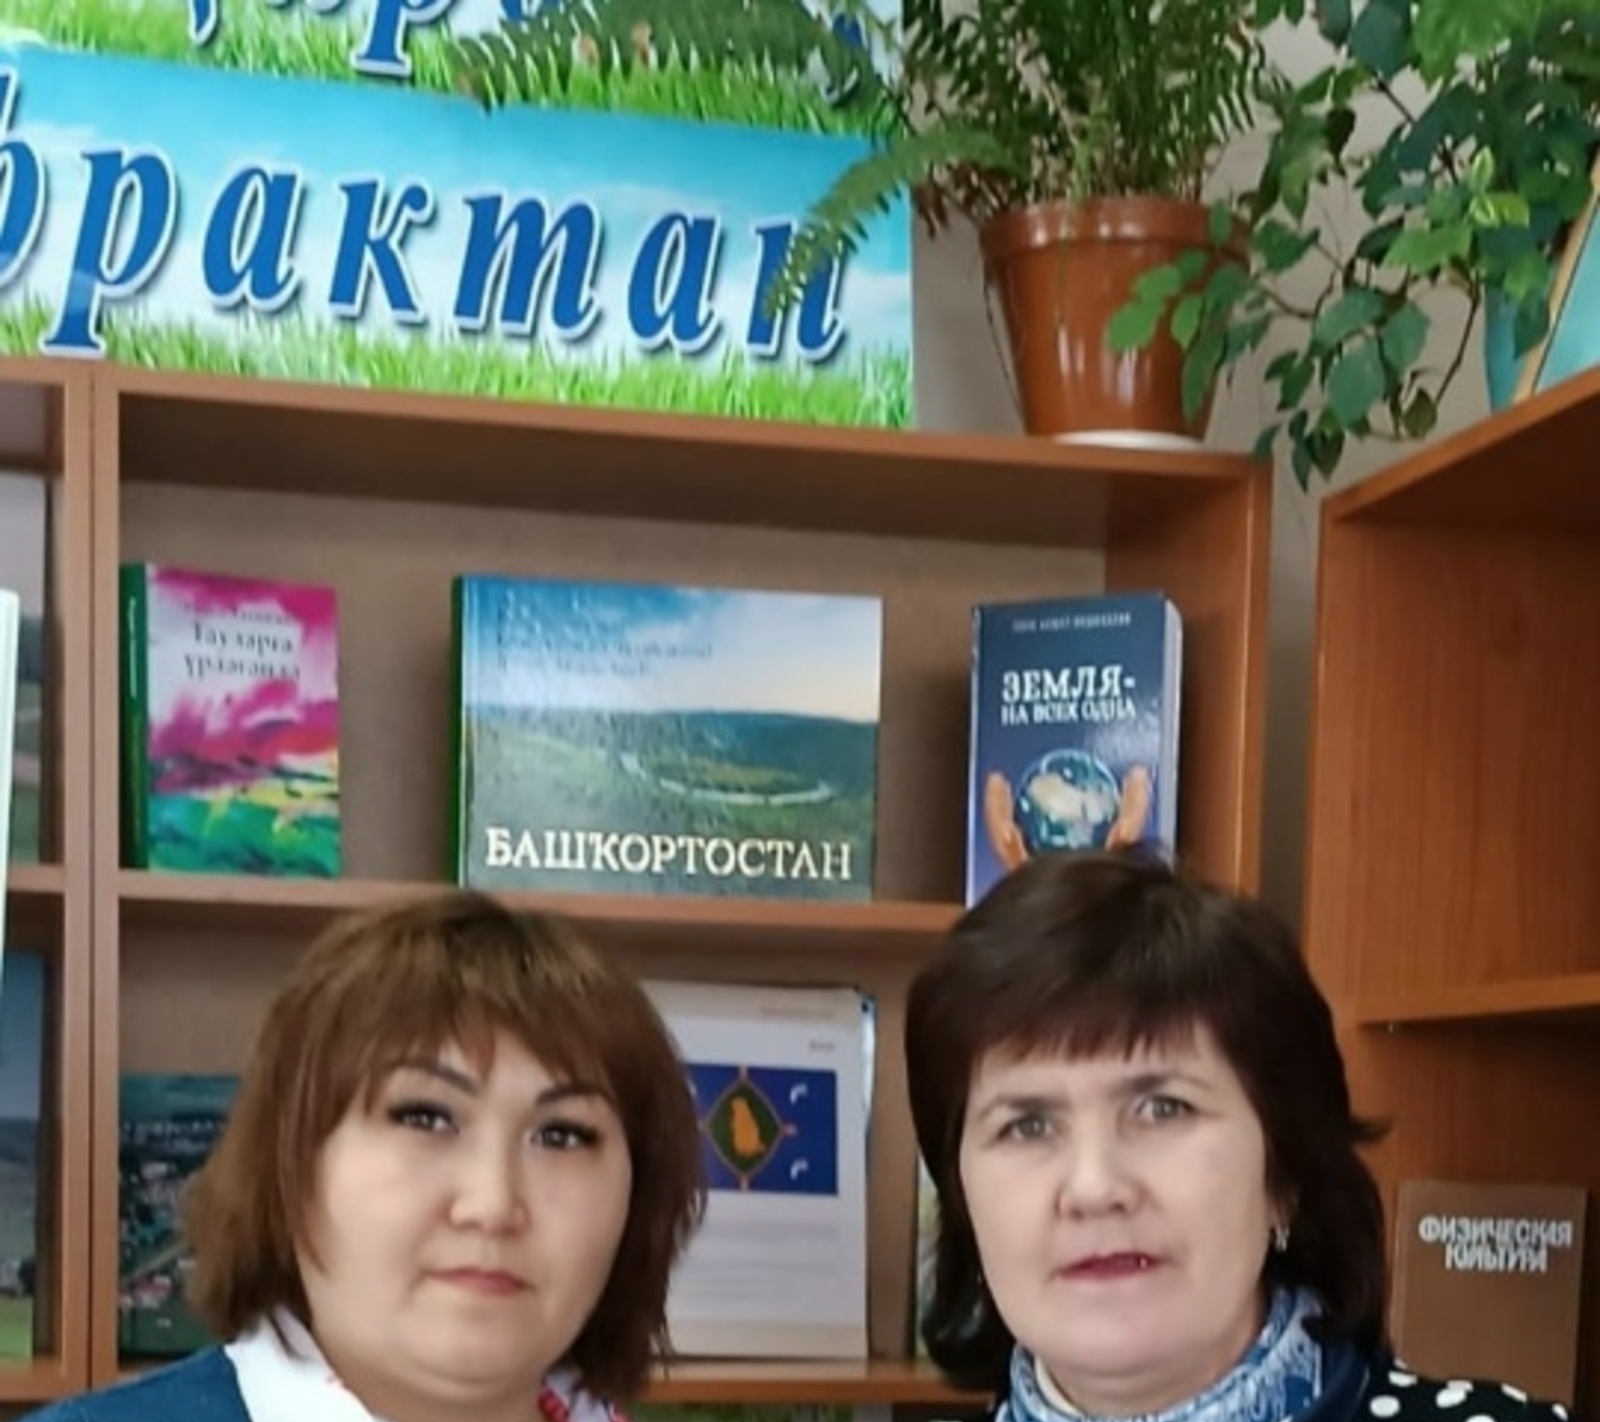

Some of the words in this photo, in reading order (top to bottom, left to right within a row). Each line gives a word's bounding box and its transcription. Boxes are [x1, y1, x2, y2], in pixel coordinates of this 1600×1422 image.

[1001, 703, 1029, 726] НА
[1033, 700, 1079, 723] ВСЕХ
[1081, 697, 1136, 722] ОДНА
[1418, 1215, 1573, 1247] ФИЗИЧЕСКАЯ
[1445, 1242, 1548, 1274] КУЛЬТУРА
